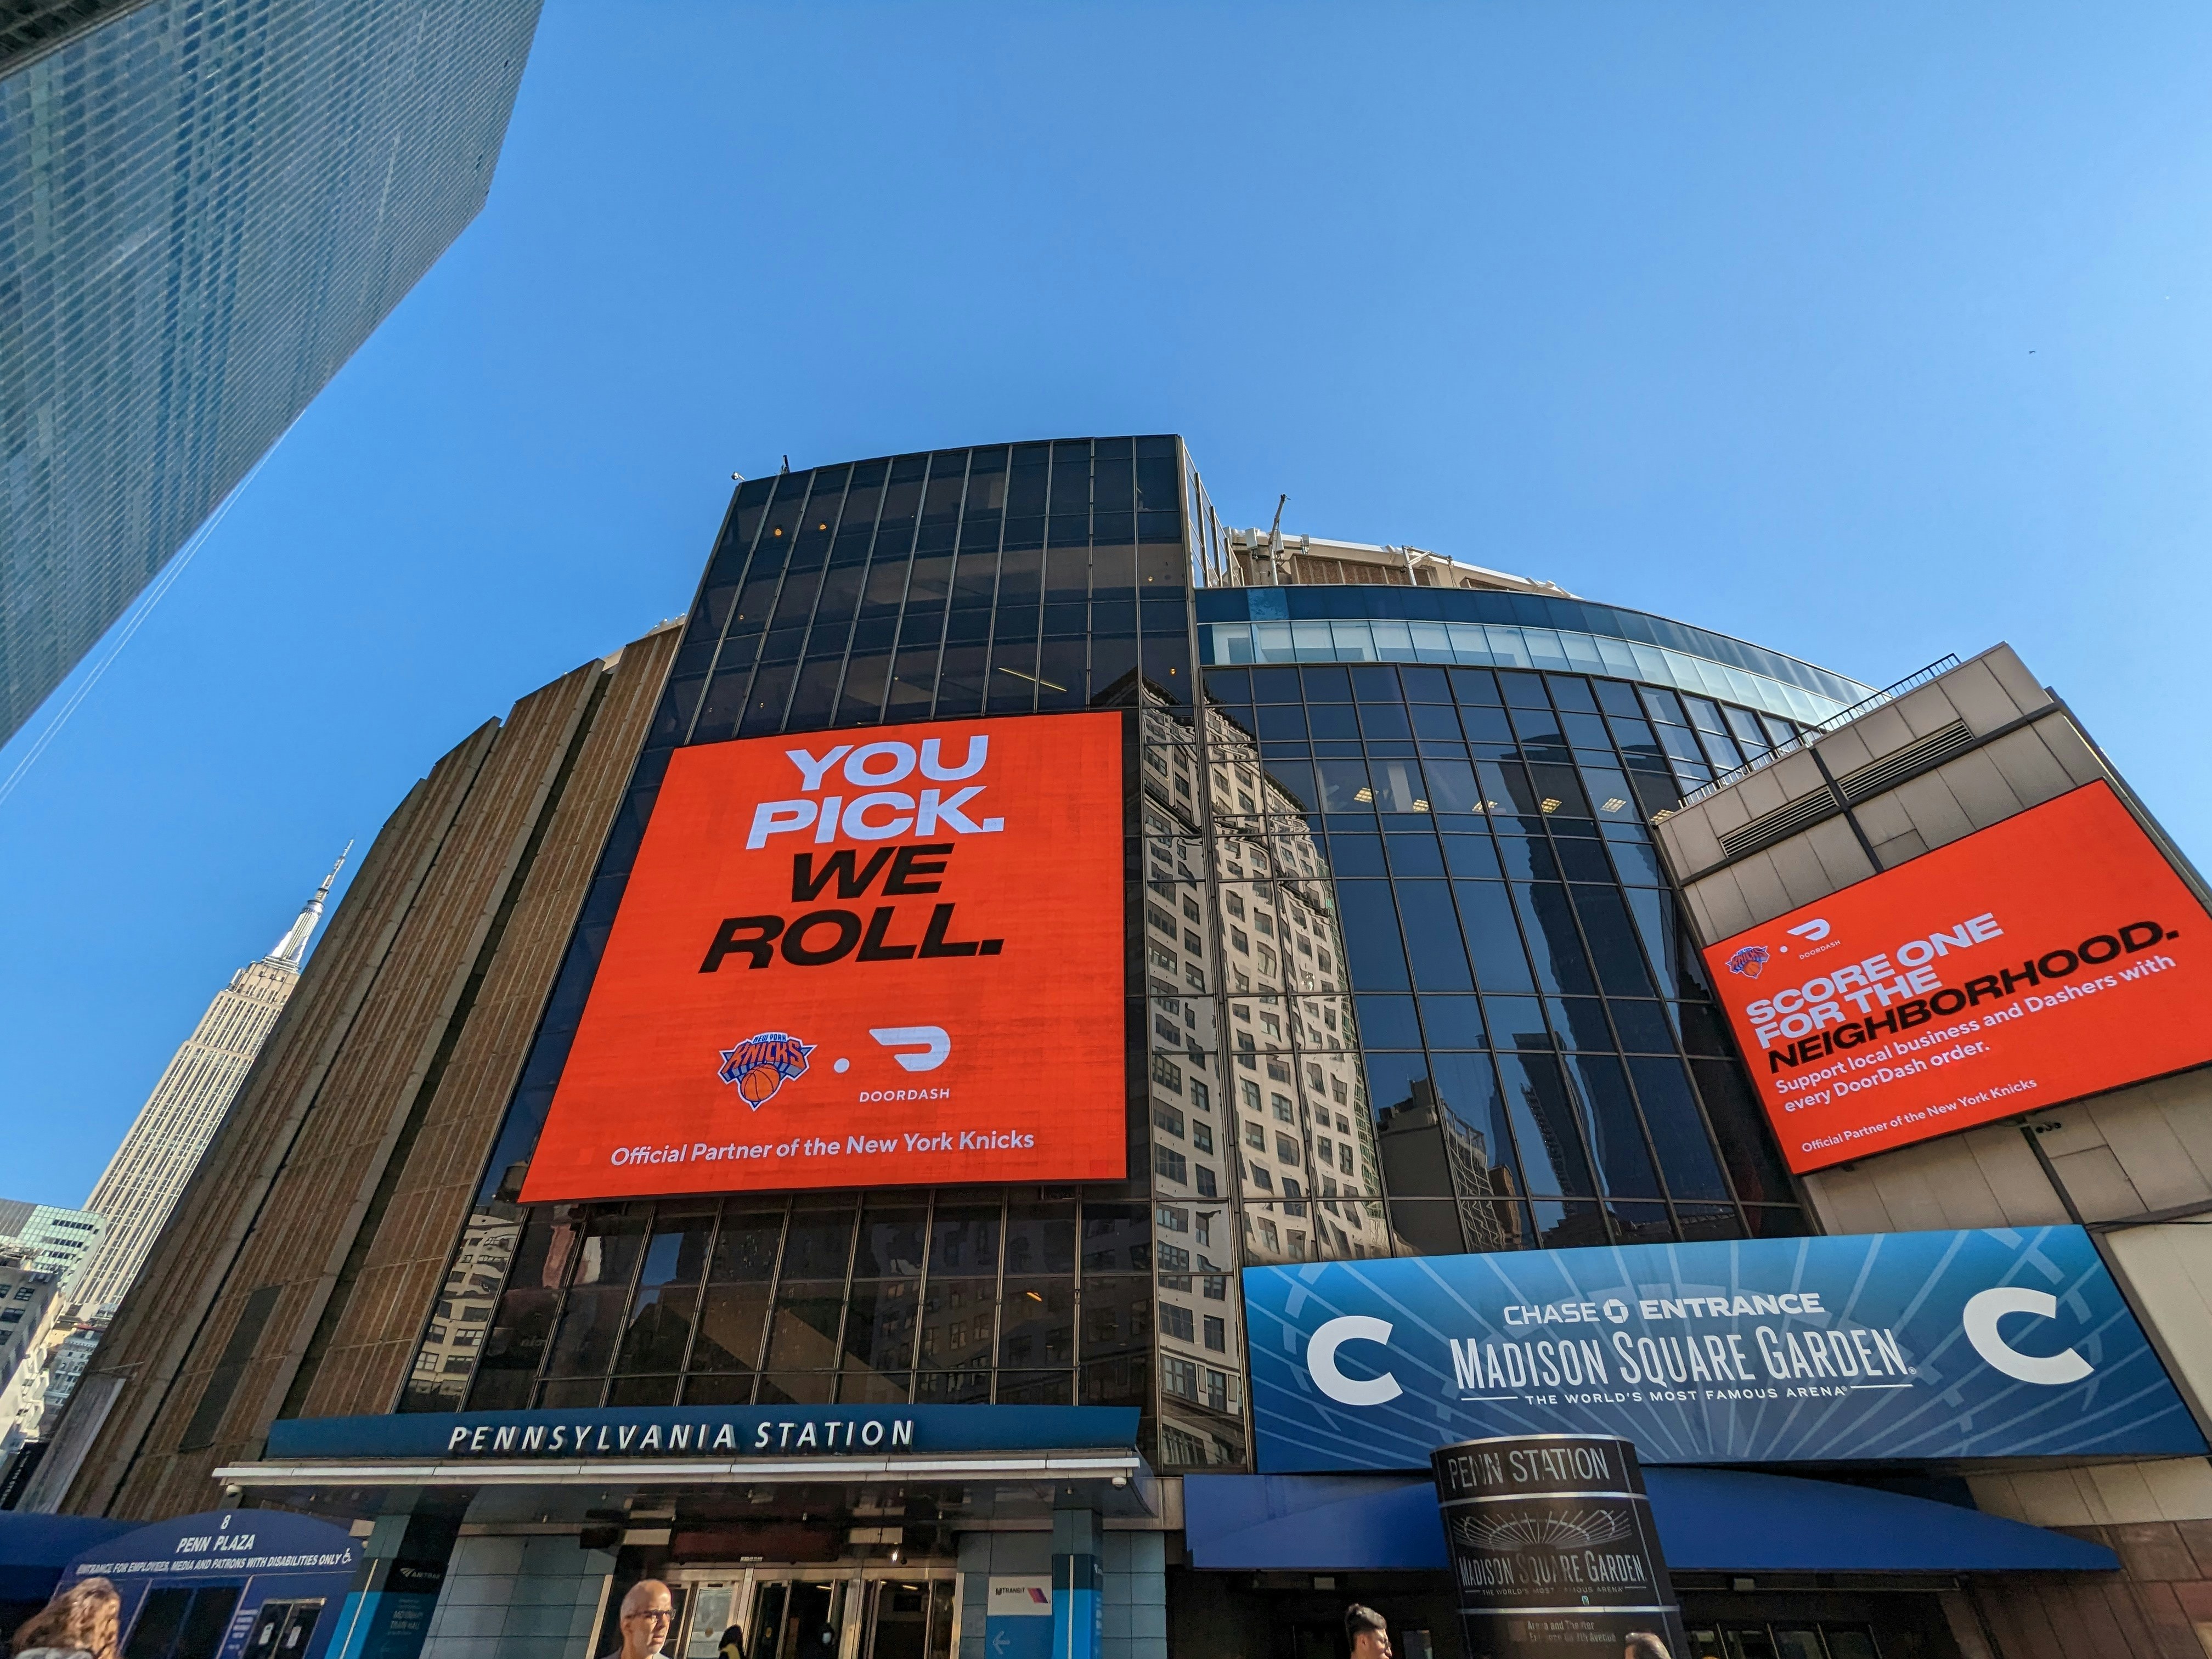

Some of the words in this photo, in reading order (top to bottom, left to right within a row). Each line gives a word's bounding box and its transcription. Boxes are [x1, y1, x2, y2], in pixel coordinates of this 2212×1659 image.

[786, 735, 989, 791] YOU
[746, 786, 1005, 849] PICK.
[792, 843, 955, 902] WE
[698, 902, 1005, 973] ROLL.
[1799, 940, 1841, 960] DOORDASH
[1746, 953, 1895, 1024] SCORE
[1897, 912, 2004, 967] ONE
[1755, 1001, 1846, 1049] FOR
[1844, 965, 1943, 1013] THE
[1768, 921, 2179, 1074] NEIGHBORHOOD.
[753, 1034, 768, 1042] NEW
[1775, 1061, 1847, 1094] Support
[1847, 1045, 1893, 1071] local
[1893, 1018, 1980, 1056] business
[1984, 1003, 2024, 1027] and
[2024, 974, 2118, 1012] Dashers
[2119, 956, 2176, 981] with
[721, 1040, 807, 1075] KNICKS
[1785, 1090, 1831, 1113] every
[1833, 1058, 1928, 1097] DoorDash
[1931, 1040, 1990, 1066] order.
[860, 1088, 950, 1103] DOORDASH
[1802, 1133, 1842, 1152] Official
[1843, 1122, 1887, 1141] Partner
[1890, 1115, 1903, 1127] of
[1904, 1111, 1925, 1124] the
[1926, 1102, 1957, 1117] New
[1957, 1092, 1990, 1108] York
[1990, 1078, 2038, 1098] Knicks
[611, 1144, 687, 1166] Official
[691, 1142, 772, 1161] Partner
[776, 1138, 800, 1157] of
[804, 1137, 840, 1156] the
[847, 1135, 898, 1154] New
[904, 1132, 953, 1152] York
[960, 1130, 1034, 1149] Knicks
[1504, 1302, 1600, 1325] CHASE
[1639, 1293, 1824, 1319] ENTRANCE
[1307, 1315, 1403, 1406] C
[1963, 1287, 2094, 1385] C
[1449, 1337, 1609, 1391] MADISON
[1613, 1331, 1756, 1388] SQUARE
[1525, 1395, 1558, 1405] THE
[1565, 1391, 1643, 1403] WORLD'S
[1650, 1391, 1697, 1402] MOST
[1707, 1389, 1778, 1400] FAMOUS
[448, 1423, 736, 1451] PENNSYLVANIA
[755, 1420, 915, 1448] STATION
[1448, 1452, 1504, 1491] PENN
[1509, 1448, 1610, 1482] STATION
[176, 1536, 212, 1553] PENN
[213, 1534, 255, 1551] PLAZA
[221, 1515, 232, 1530] 8
[112, 1562, 127, 1573] FOR
[171, 1560, 194, 1571] MEDIA
[194, 1559, 212, 1570] AND
[213, 1558, 247, 1569] PATRONS
[246, 1556, 266, 1568] WITH
[267, 1554, 318, 1567] DISABILITIES
[319, 1553, 343, 1565] ONLY
[1550, 1620, 1564, 1630] and
